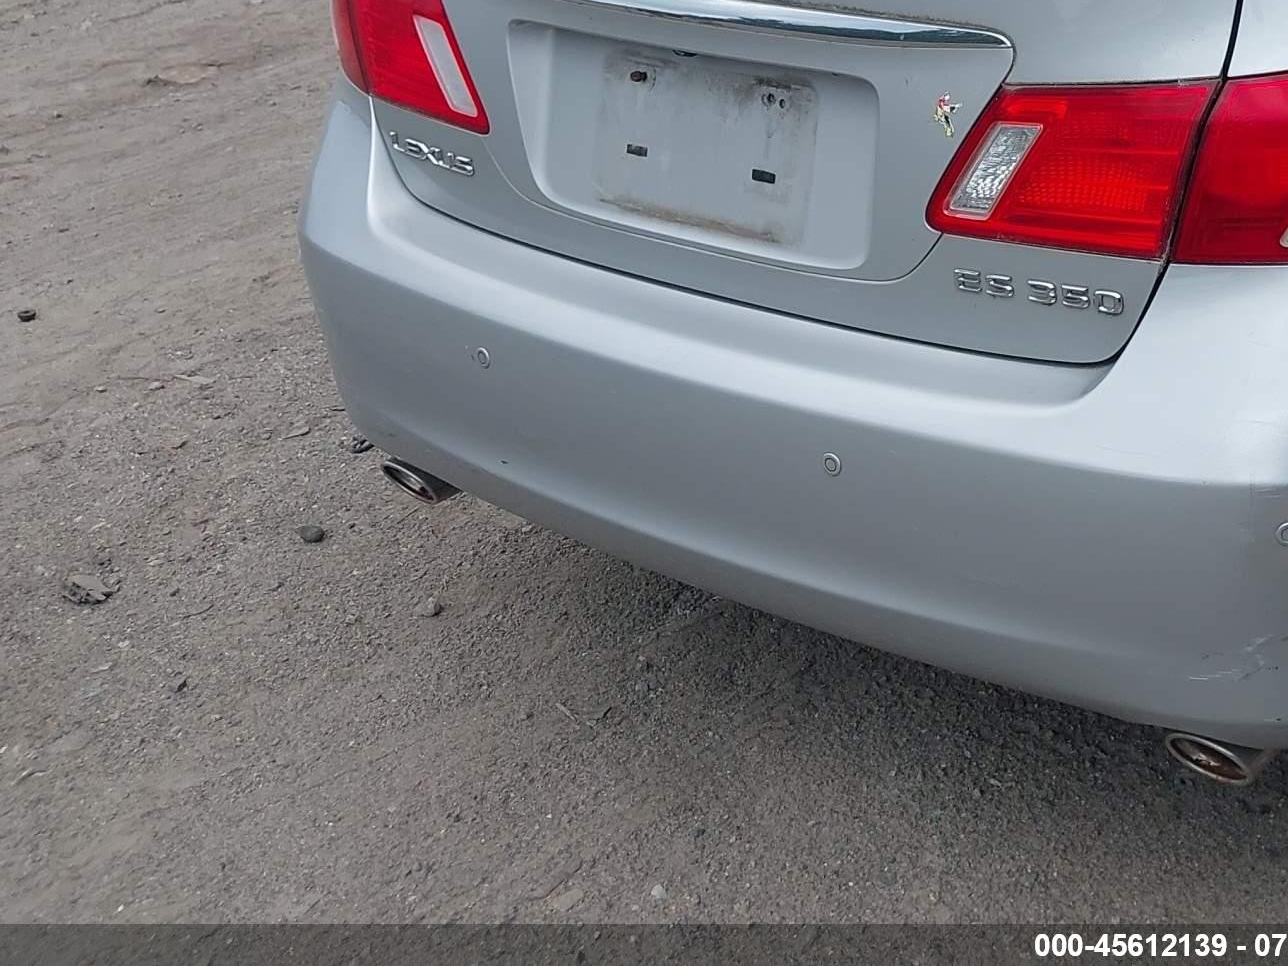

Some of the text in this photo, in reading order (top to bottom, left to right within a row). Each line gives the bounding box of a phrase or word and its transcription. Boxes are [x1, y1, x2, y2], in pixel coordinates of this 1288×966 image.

[389, 130, 475, 176] LEXUS
[953, 268, 1124, 316] ES 350
